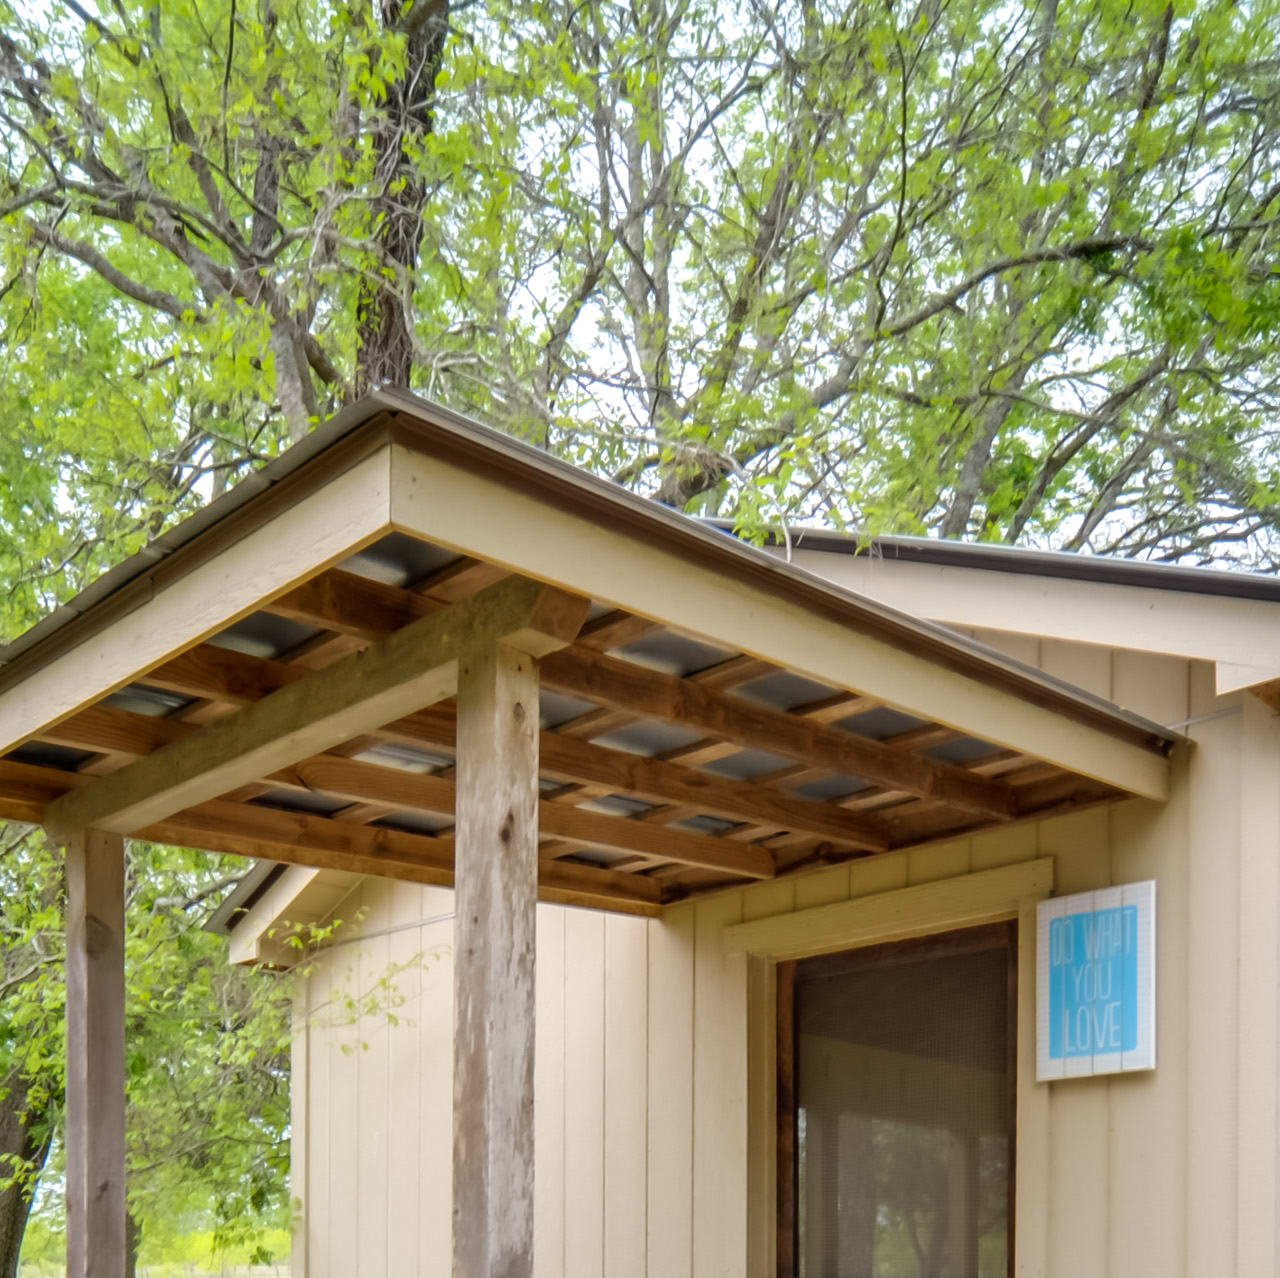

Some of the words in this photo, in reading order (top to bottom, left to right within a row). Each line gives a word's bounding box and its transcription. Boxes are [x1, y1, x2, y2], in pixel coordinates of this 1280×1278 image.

[1052, 919, 1074, 966] DO
[1083, 909, 1134, 961] WHAT
[1072, 961, 1113, 1002] YOU
[1064, 1001, 1122, 1053] LOVE
